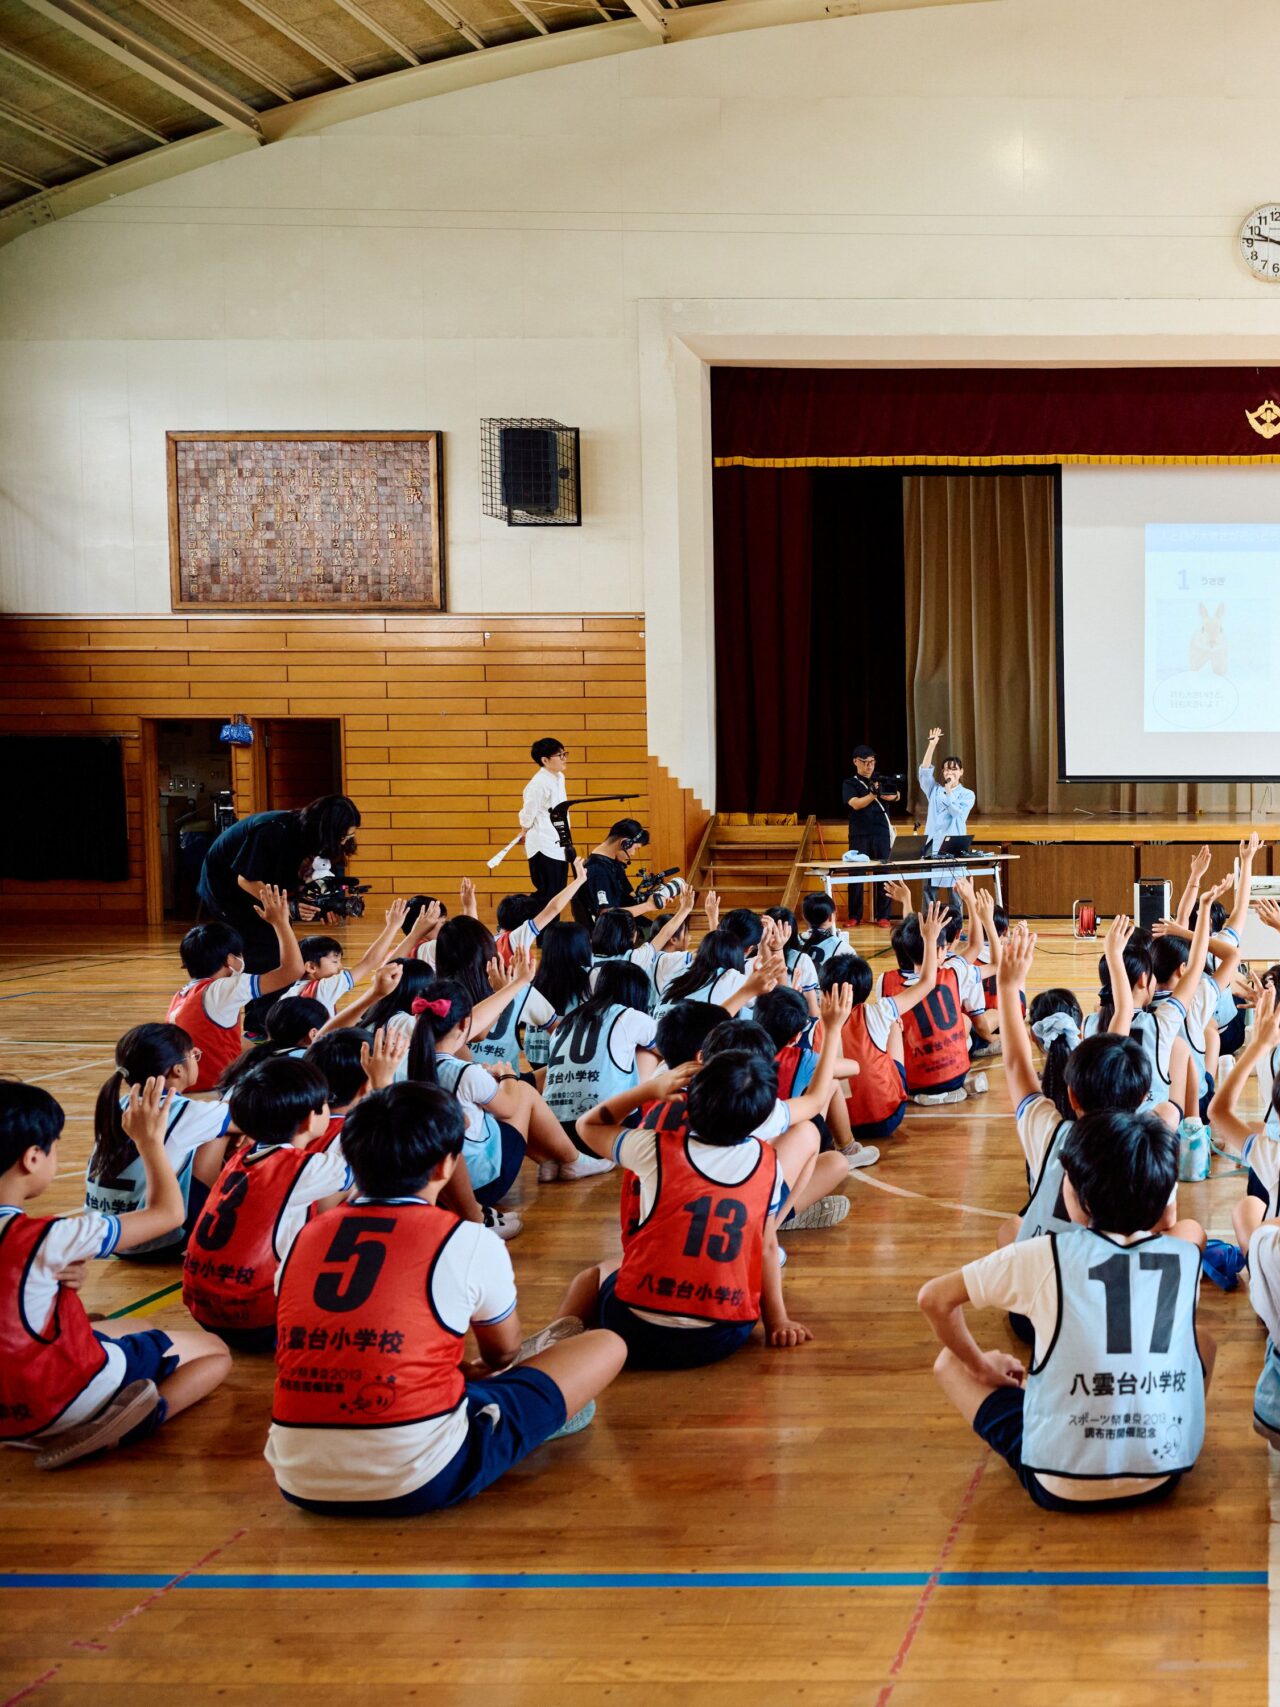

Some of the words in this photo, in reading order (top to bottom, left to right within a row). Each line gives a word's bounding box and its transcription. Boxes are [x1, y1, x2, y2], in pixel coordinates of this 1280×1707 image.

[1257, 216, 1267, 226] 11
[1270, 211, 1280, 221] 12
[1248, 226, 1261, 236] 10
[1246, 238, 1254, 248] 9
[1250, 251, 1258, 260] 8
[1261, 260, 1268, 270] 7
[1272, 263, 1280, 273] 6
[1178, 568, 1190, 590] 1
[1200, 576, 1226, 587] うさぎ
[196, 1171, 249, 1250] 3
[682, 1195, 748, 1263] 13
[313, 1216, 397, 1313] 5
[1088, 1252, 1181, 1354] 17
[1069, 1370, 1187, 1396] 八雲台小学校
